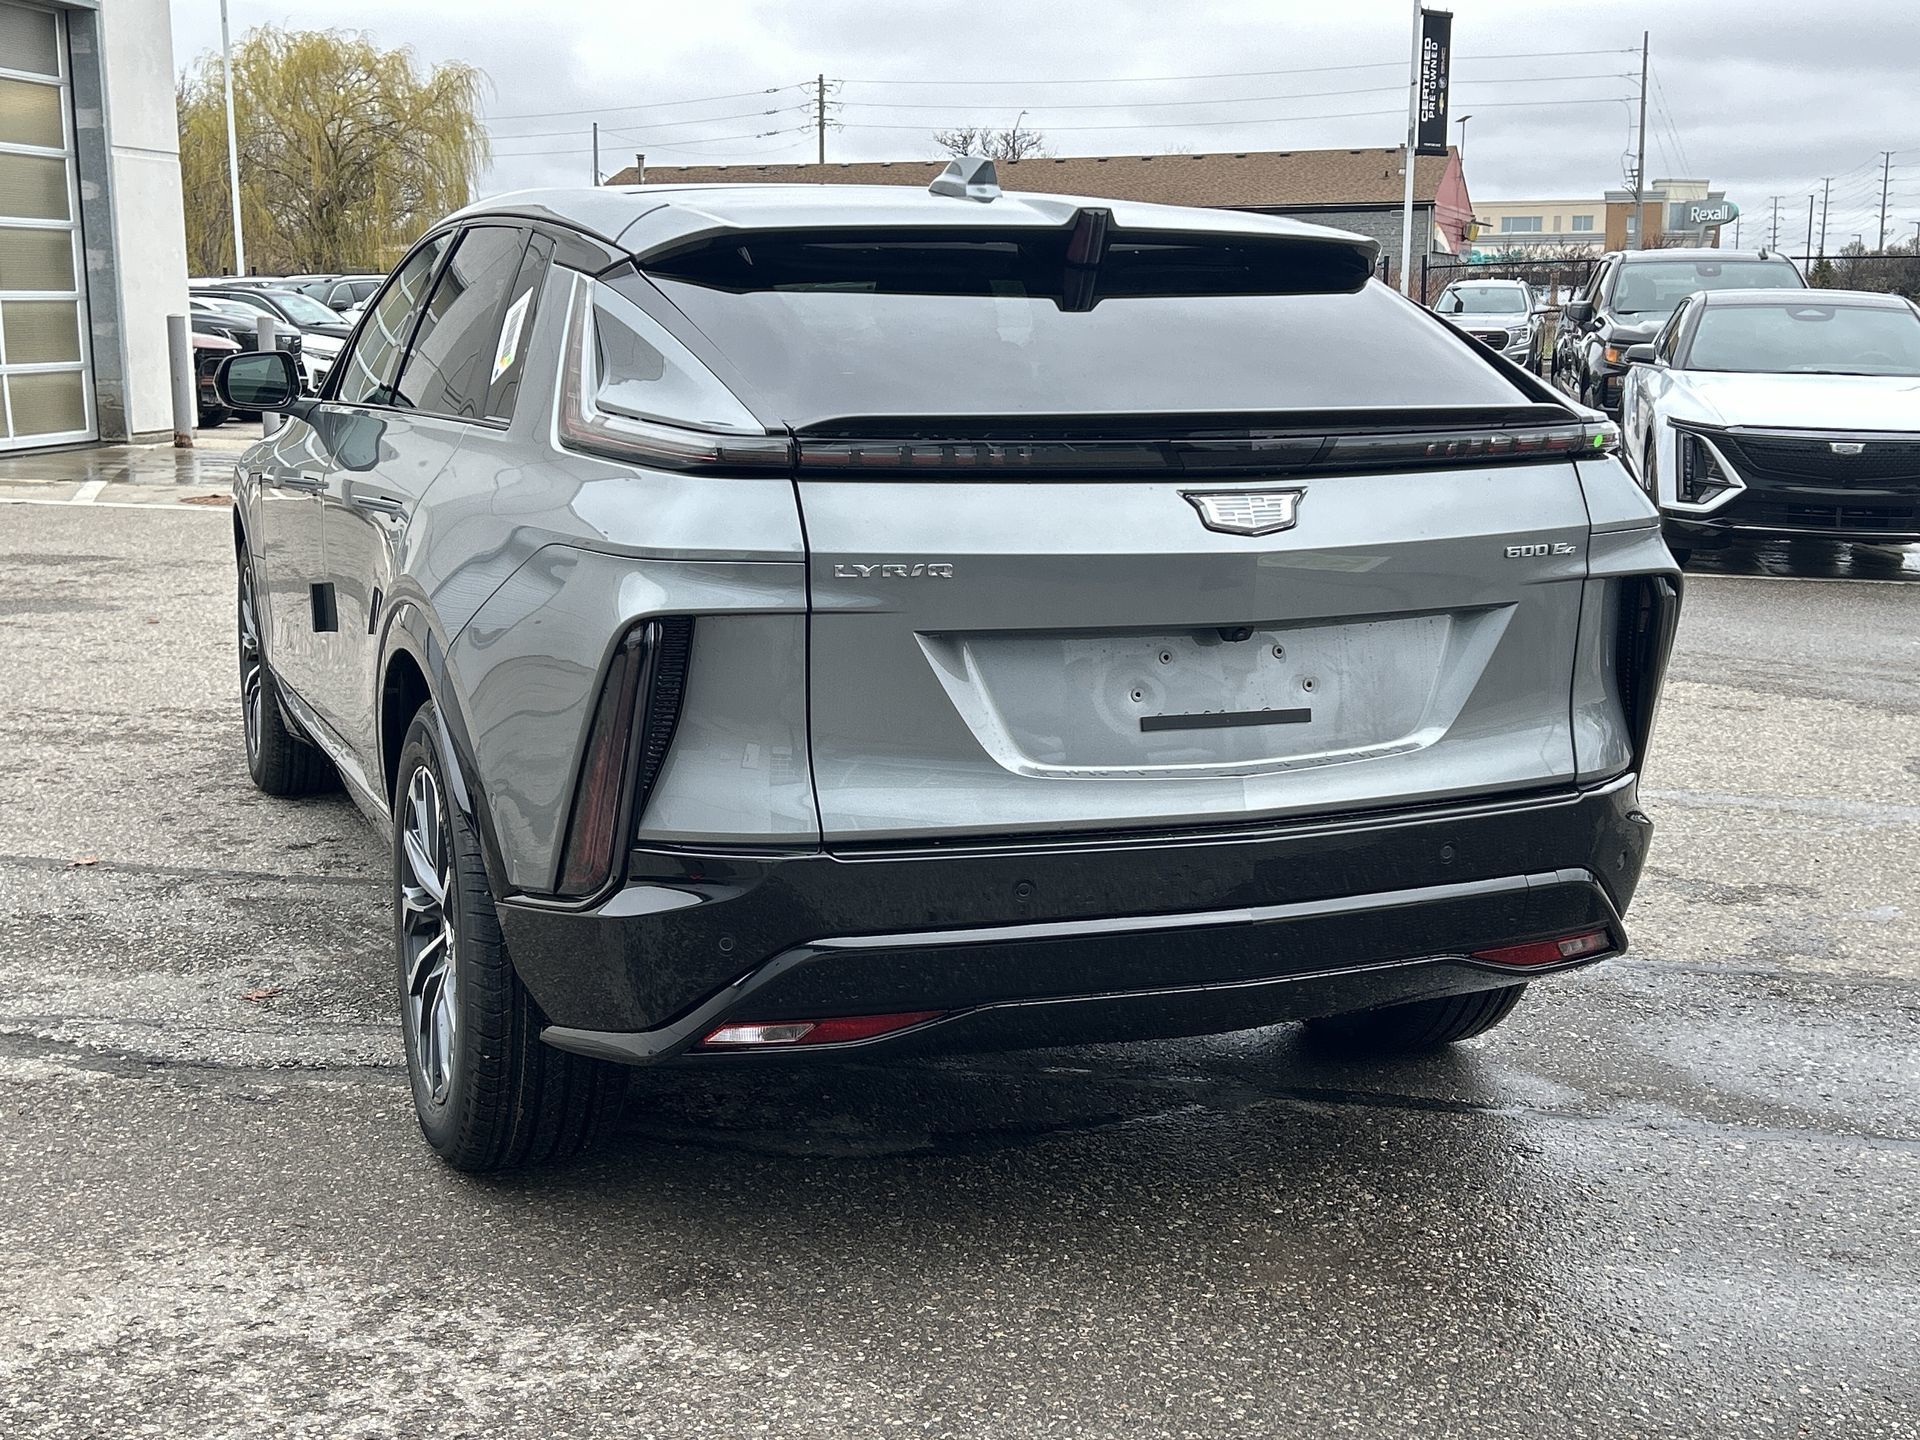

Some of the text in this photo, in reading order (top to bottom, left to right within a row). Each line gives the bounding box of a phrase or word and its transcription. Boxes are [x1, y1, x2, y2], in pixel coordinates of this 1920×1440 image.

[1421, 37, 1432, 122] CERTIFIED
[1428, 42, 1438, 119] PRE-OWNED
[1690, 205, 1728, 222] Rexall
[1504, 544, 1549, 558] 600
[834, 563, 953, 578] LYRIQ
